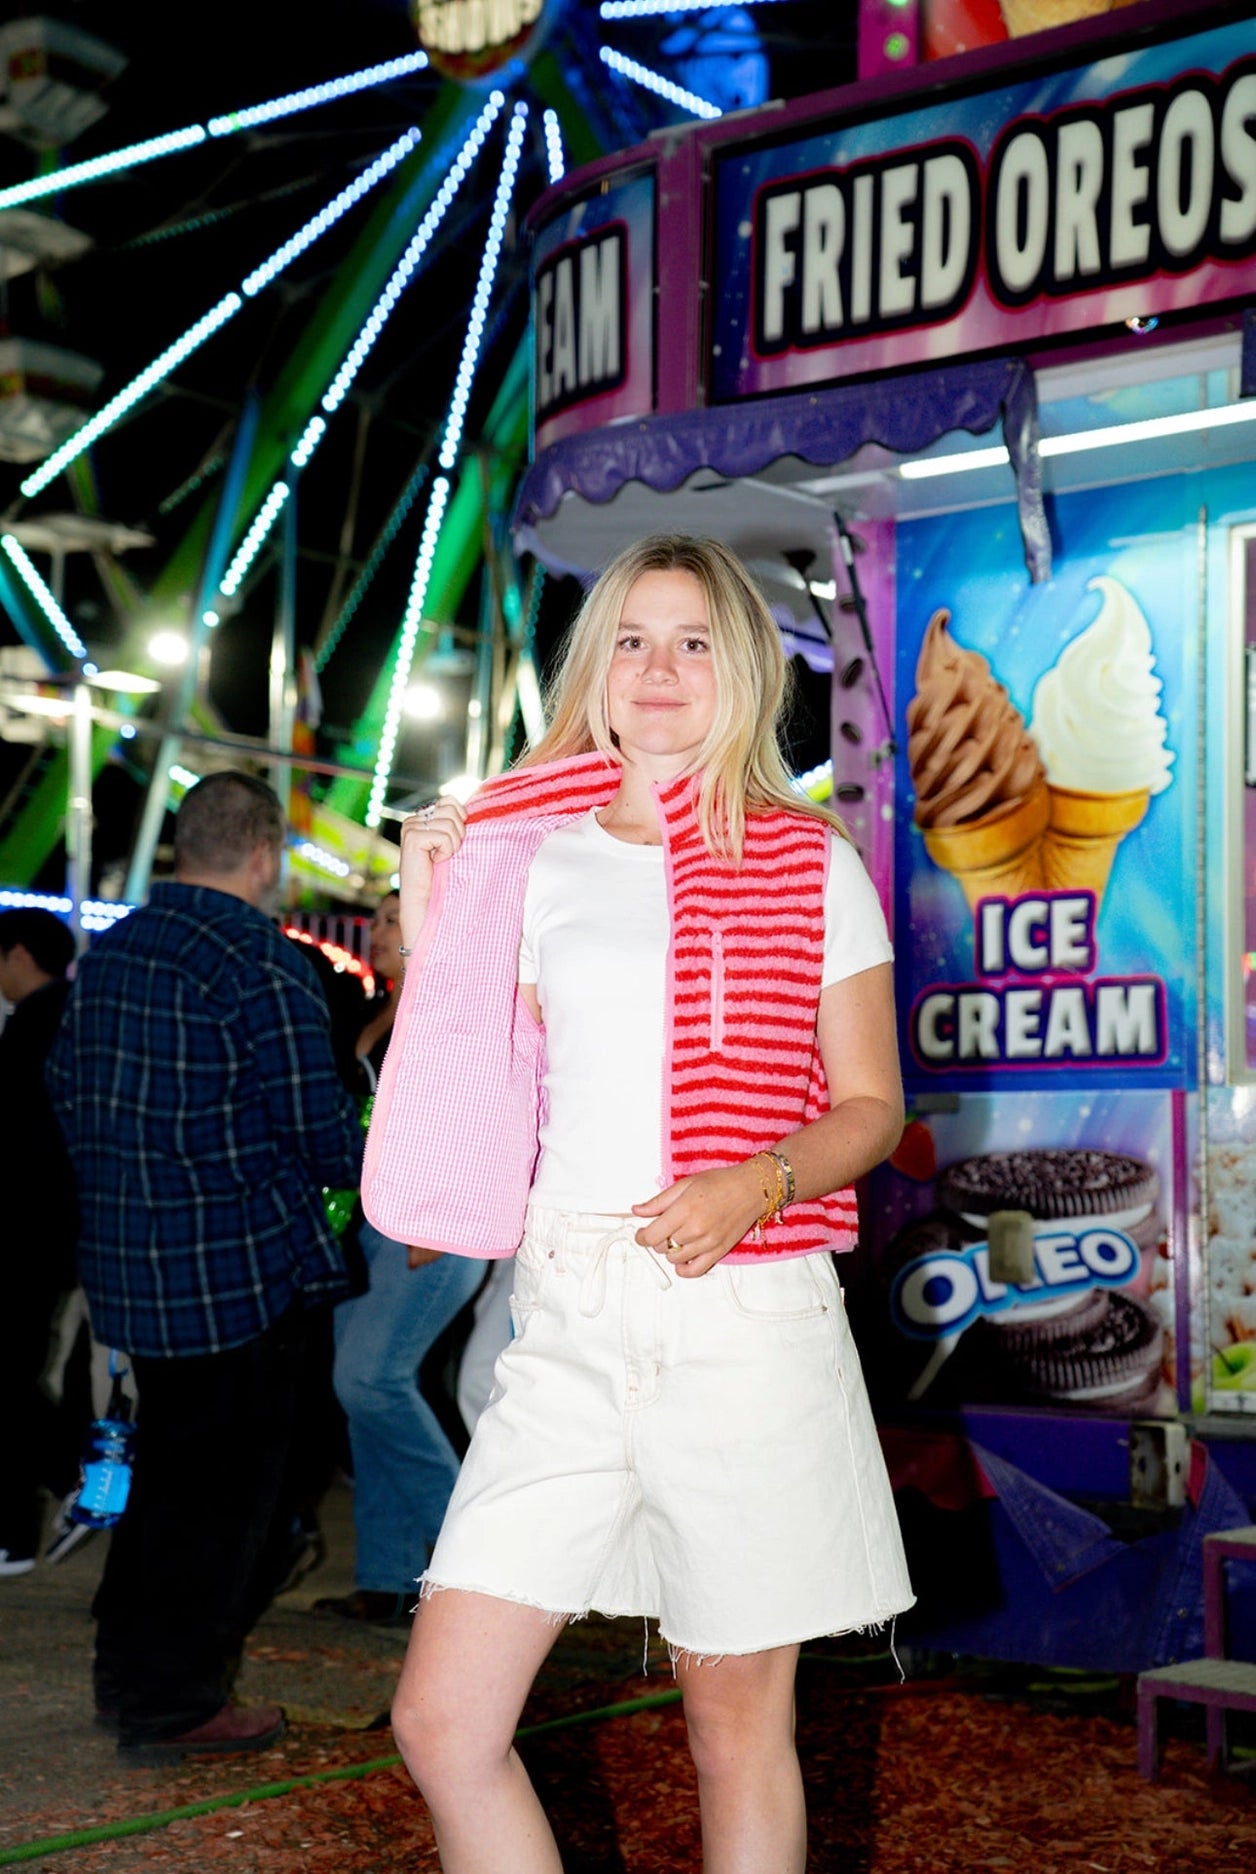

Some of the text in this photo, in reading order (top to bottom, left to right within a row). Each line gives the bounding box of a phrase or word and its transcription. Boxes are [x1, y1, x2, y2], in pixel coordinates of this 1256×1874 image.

[764, 73, 1256, 342] FRIED OREOS
[983, 899, 1090, 972] ICE
[918, 985, 1156, 1058] CREAM
